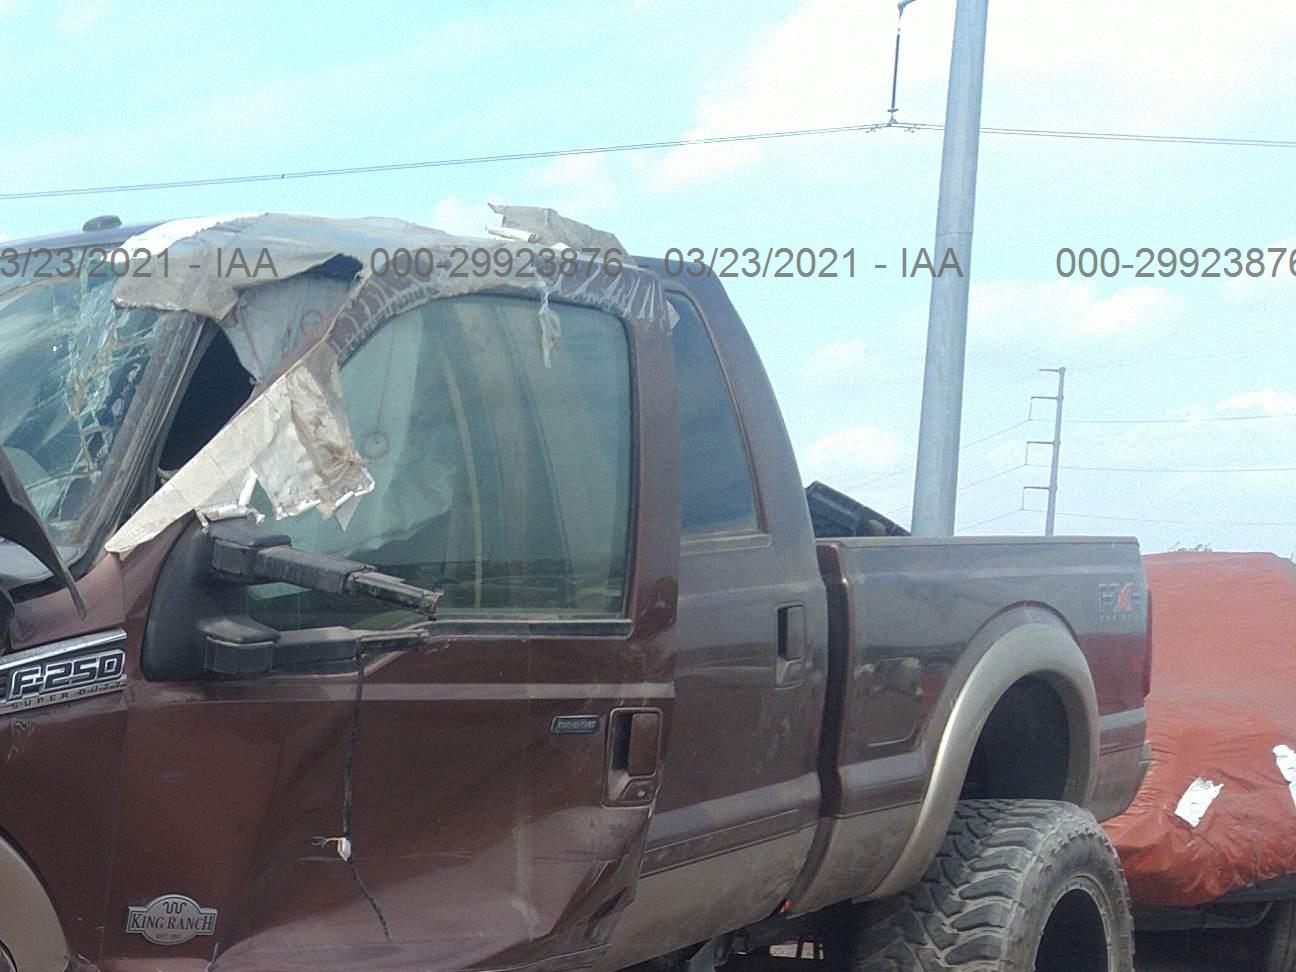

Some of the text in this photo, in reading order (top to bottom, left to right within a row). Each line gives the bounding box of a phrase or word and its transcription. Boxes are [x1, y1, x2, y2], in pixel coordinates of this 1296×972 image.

[6, 649, 126, 701] F-250
[131, 913, 214, 931] KING RANCH
